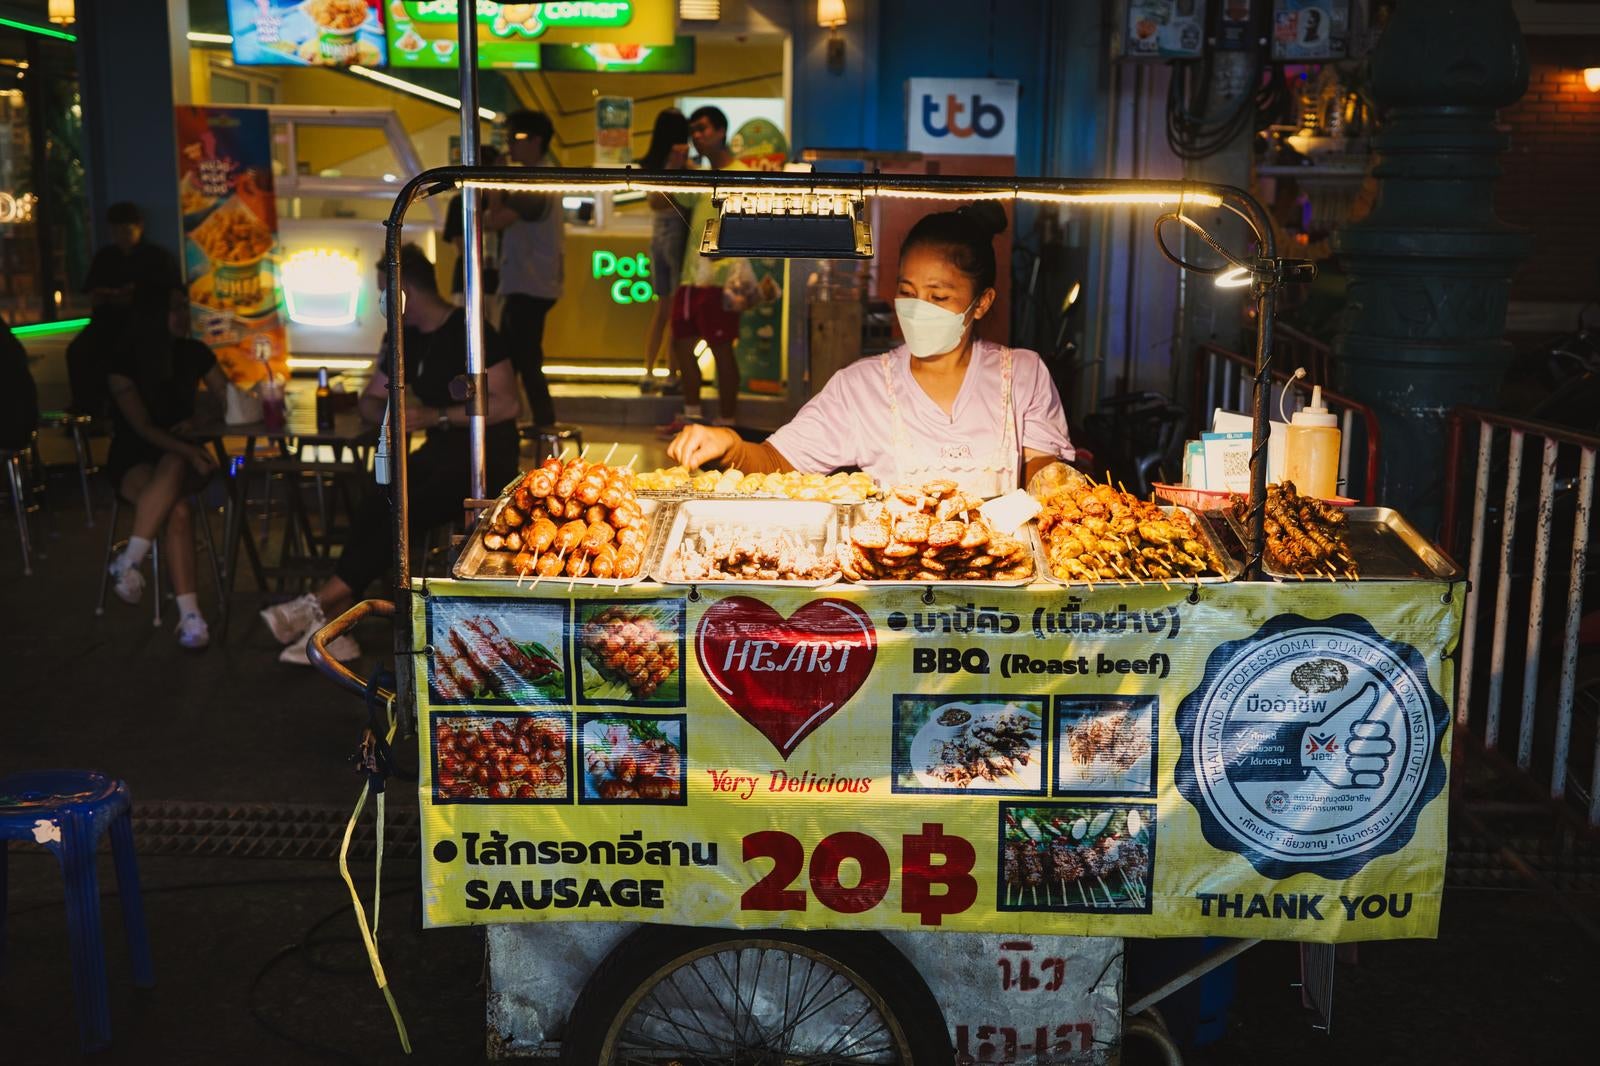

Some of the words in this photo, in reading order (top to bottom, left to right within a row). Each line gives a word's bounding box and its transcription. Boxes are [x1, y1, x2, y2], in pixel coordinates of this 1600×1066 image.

[922, 93, 1005, 139] ttb
[593, 250, 651, 279] Pot
[1032, 597, 1181, 640] (เนื้อย่าง)
[722, 640, 861, 674] HEART
[913, 648, 990, 675] BBQ
[1000, 654, 1088, 678] (Roast
[1097, 654, 1171, 678] beef)
[1205, 709, 1225, 786] THAILAND
[1221, 638, 1320, 704] PROFESSIONAL
[1327, 638, 1416, 705] QUALIFICATION
[1405, 710, 1426, 785] INSTITUTE
[706, 769, 759, 800] Very
[768, 769, 872, 794] Delicious
[462, 830, 718, 867] ไส้กรอกอีสาน
[465, 879, 665, 910] SAUSAGE
[1196, 893, 1324, 920] THANK
[1339, 893, 1413, 921] YOU
